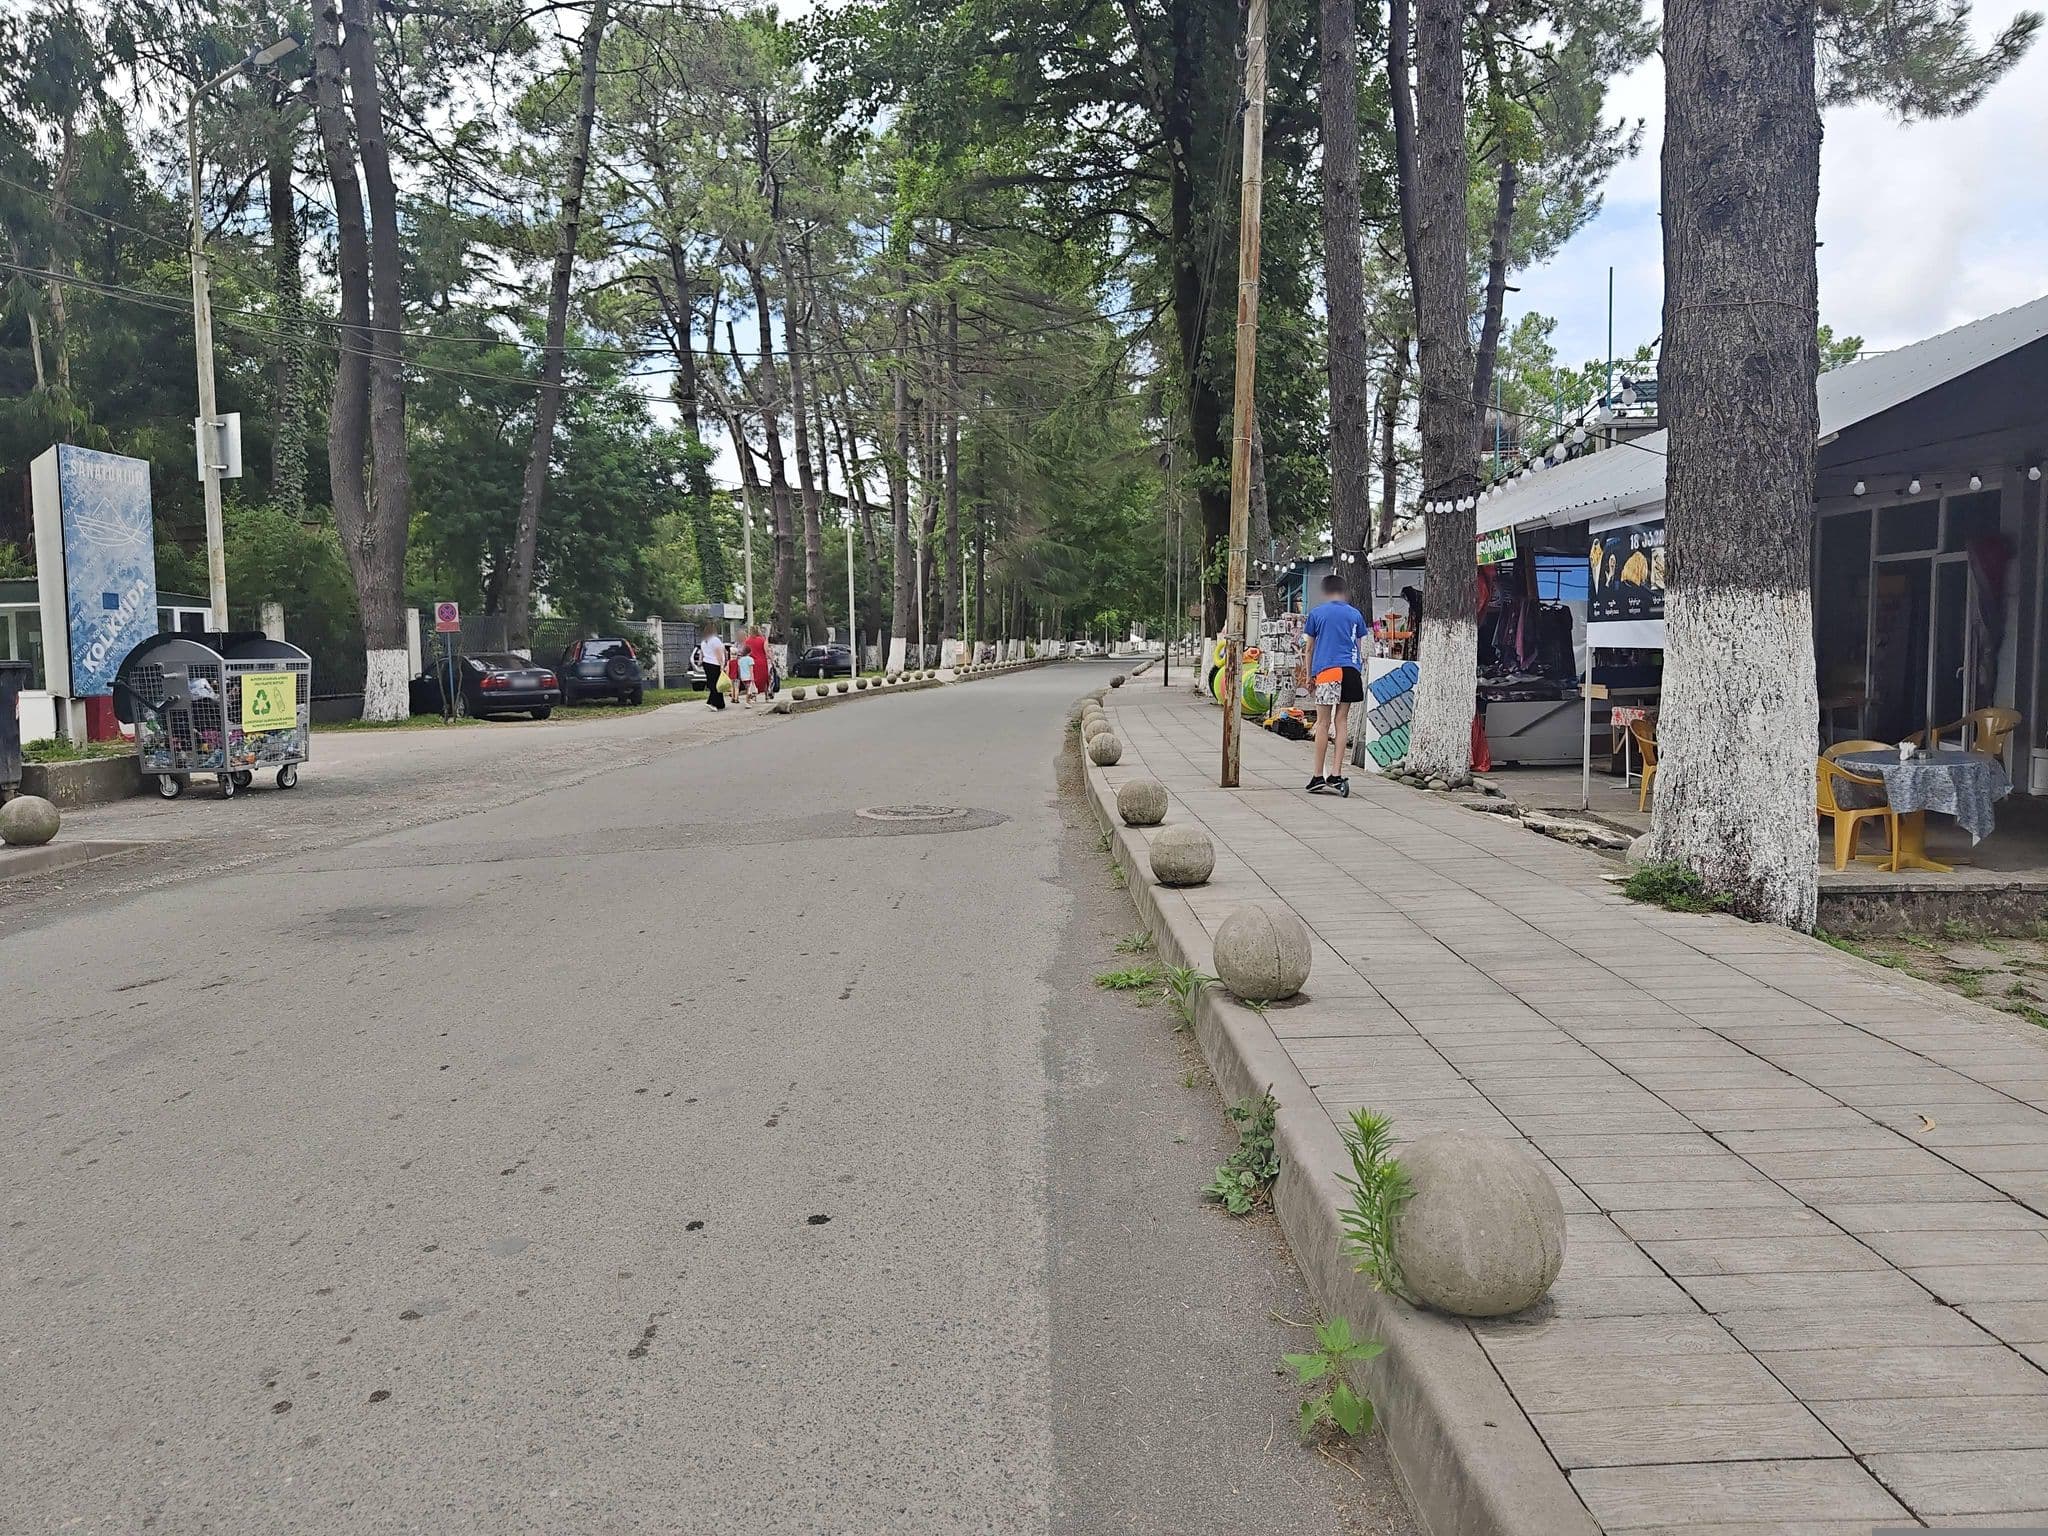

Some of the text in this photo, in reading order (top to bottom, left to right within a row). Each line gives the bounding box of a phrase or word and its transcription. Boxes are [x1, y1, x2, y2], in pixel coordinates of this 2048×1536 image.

[71, 460, 144, 487] SANATORIUM
[82, 578, 149, 674] KOLKHIDA
[1367, 661, 1420, 705] ПИВО
[1366, 721, 1411, 767] ВОД
